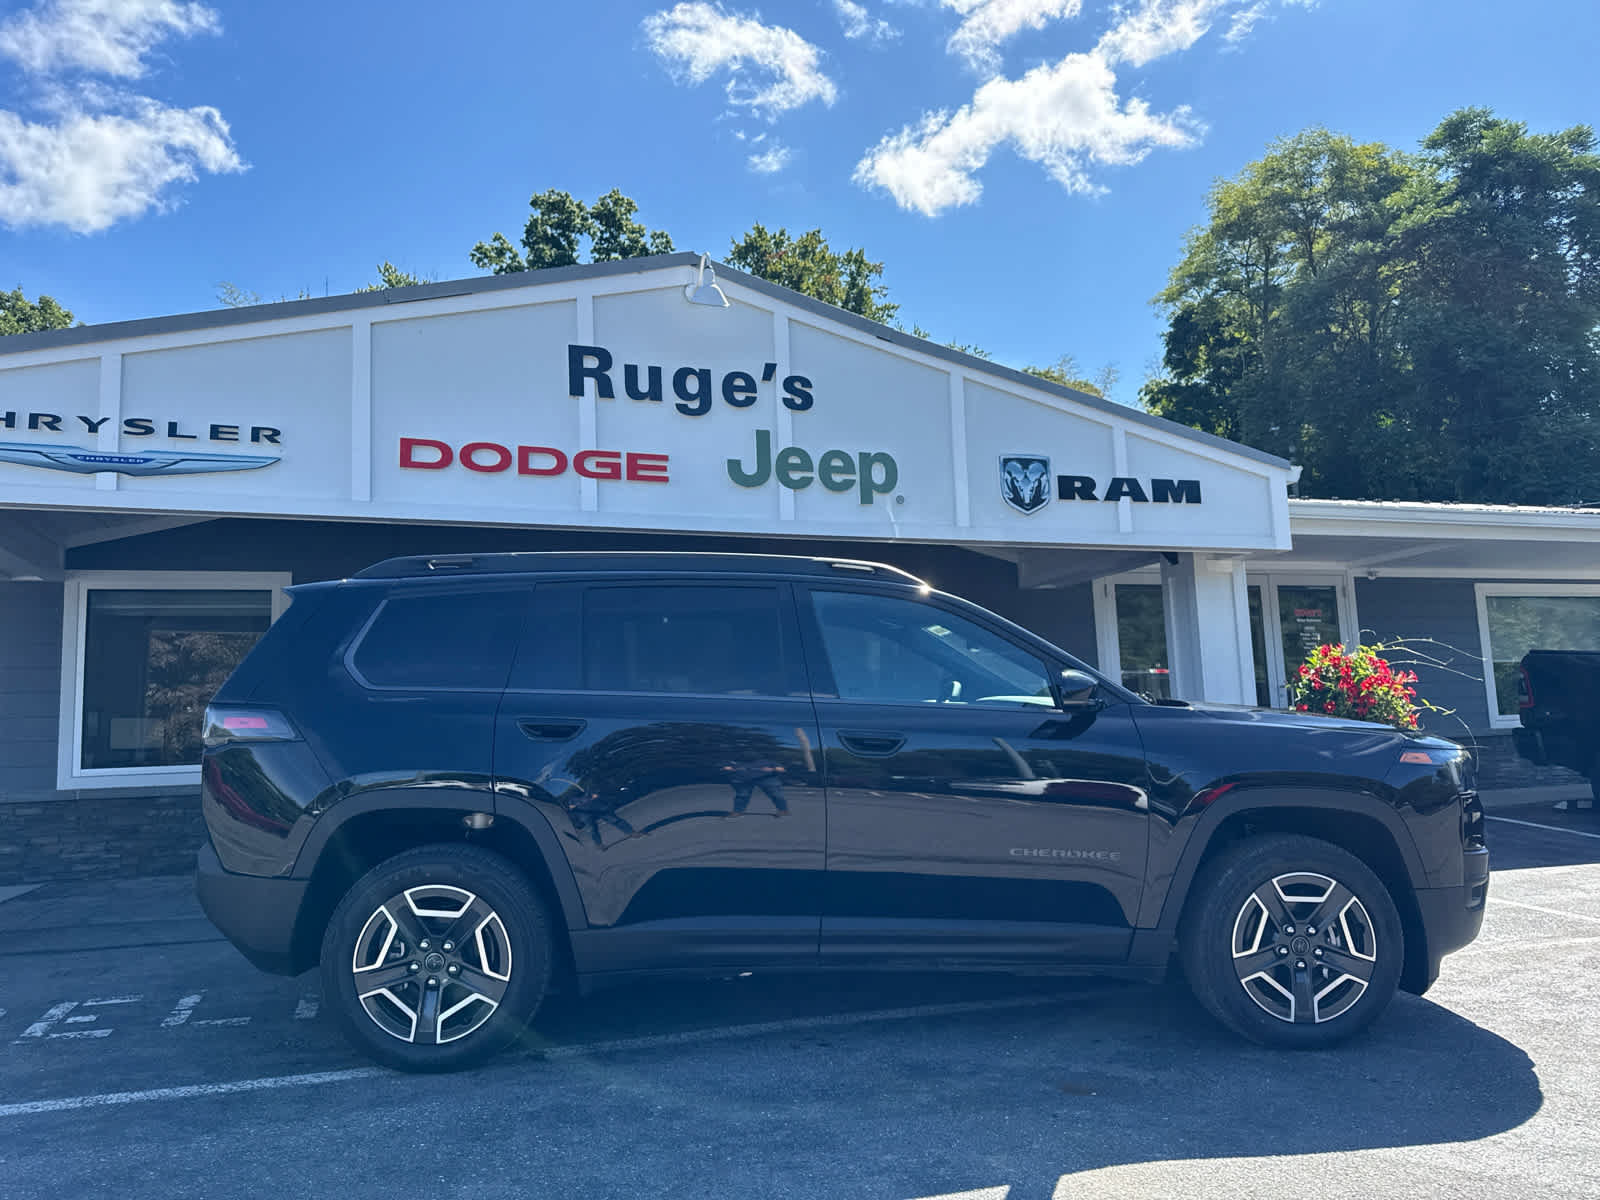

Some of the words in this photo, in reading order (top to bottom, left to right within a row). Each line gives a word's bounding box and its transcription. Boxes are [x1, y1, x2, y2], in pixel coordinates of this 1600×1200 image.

[567, 344, 814, 416] Ruge's
[400, 437, 670, 483] DODGE
[727, 429, 898, 505] Jeep
[1057, 474, 1202, 504] RAM
[1009, 848, 1121, 861] CHEROKEE
